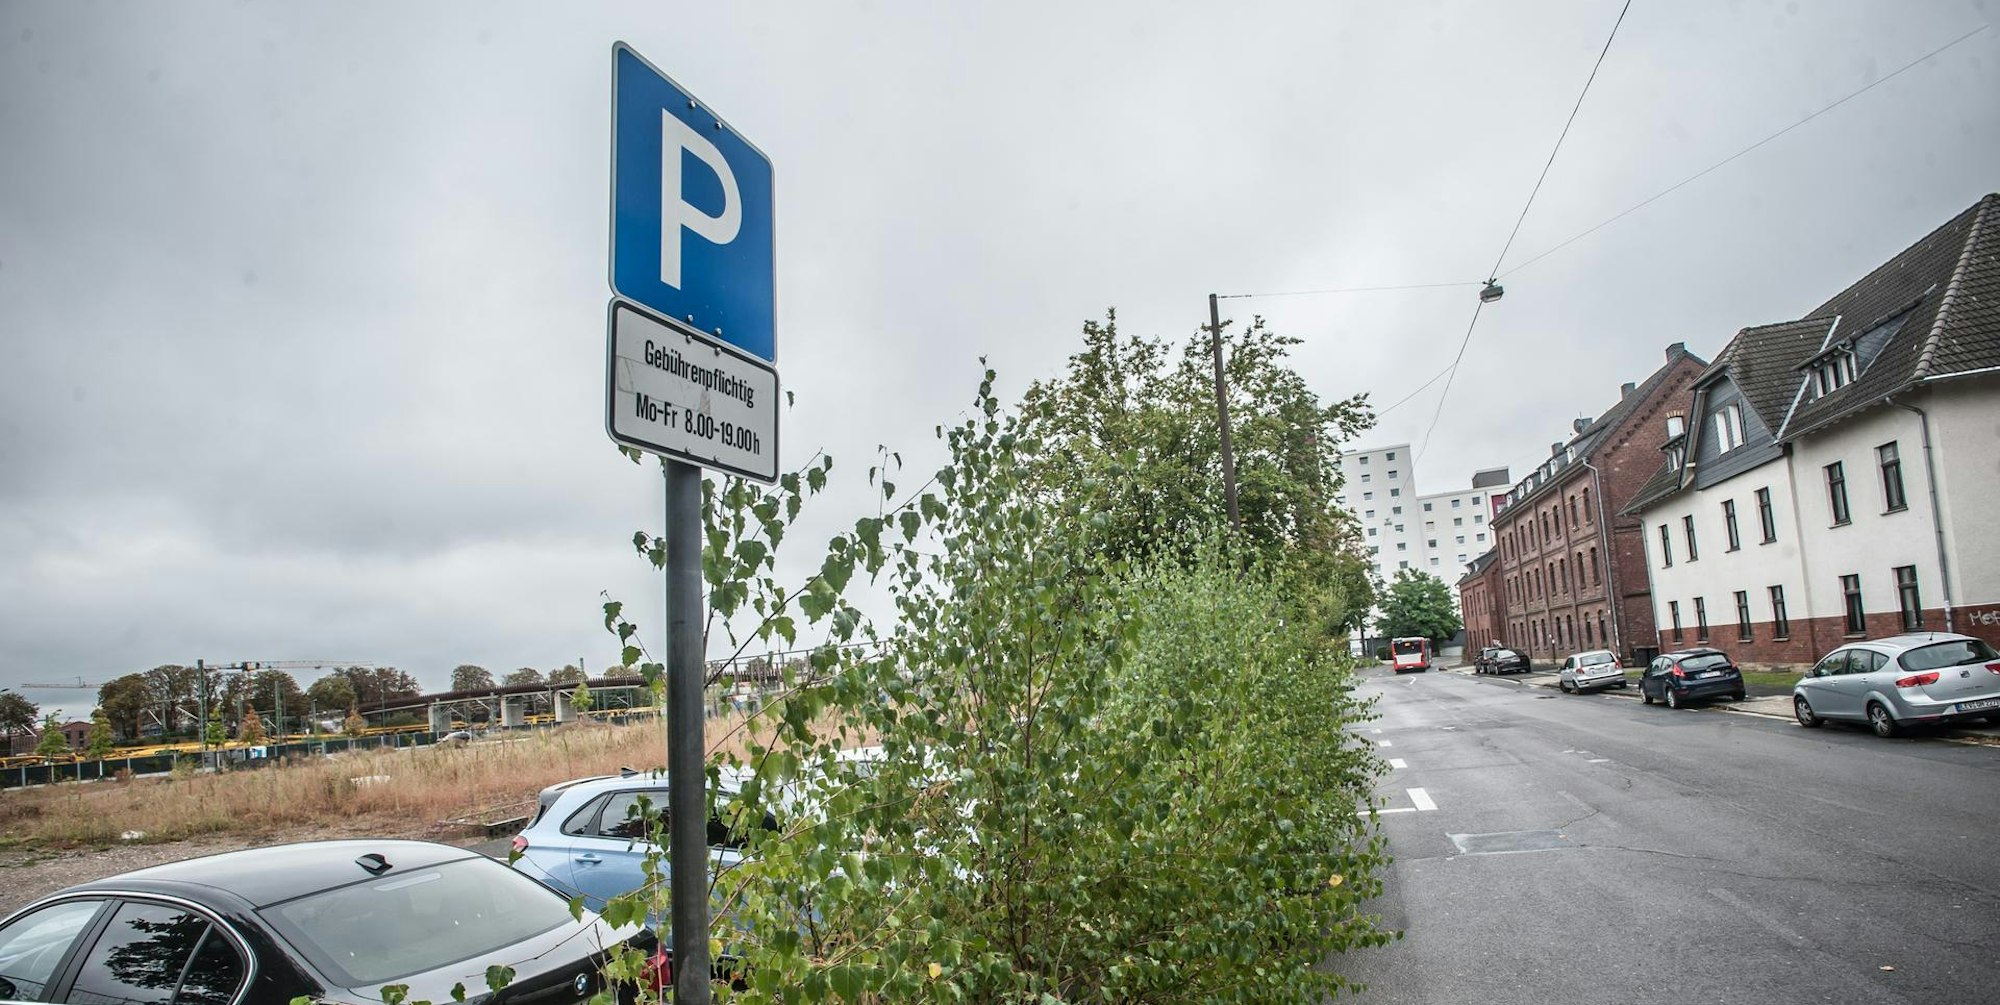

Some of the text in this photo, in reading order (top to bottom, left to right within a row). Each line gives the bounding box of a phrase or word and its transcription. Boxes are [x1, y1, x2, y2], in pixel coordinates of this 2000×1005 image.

[660, 108, 742, 290] P
[645, 339, 754, 409] Gebührenpflichtig
[636, 392, 678, 428] Mo-Fr
